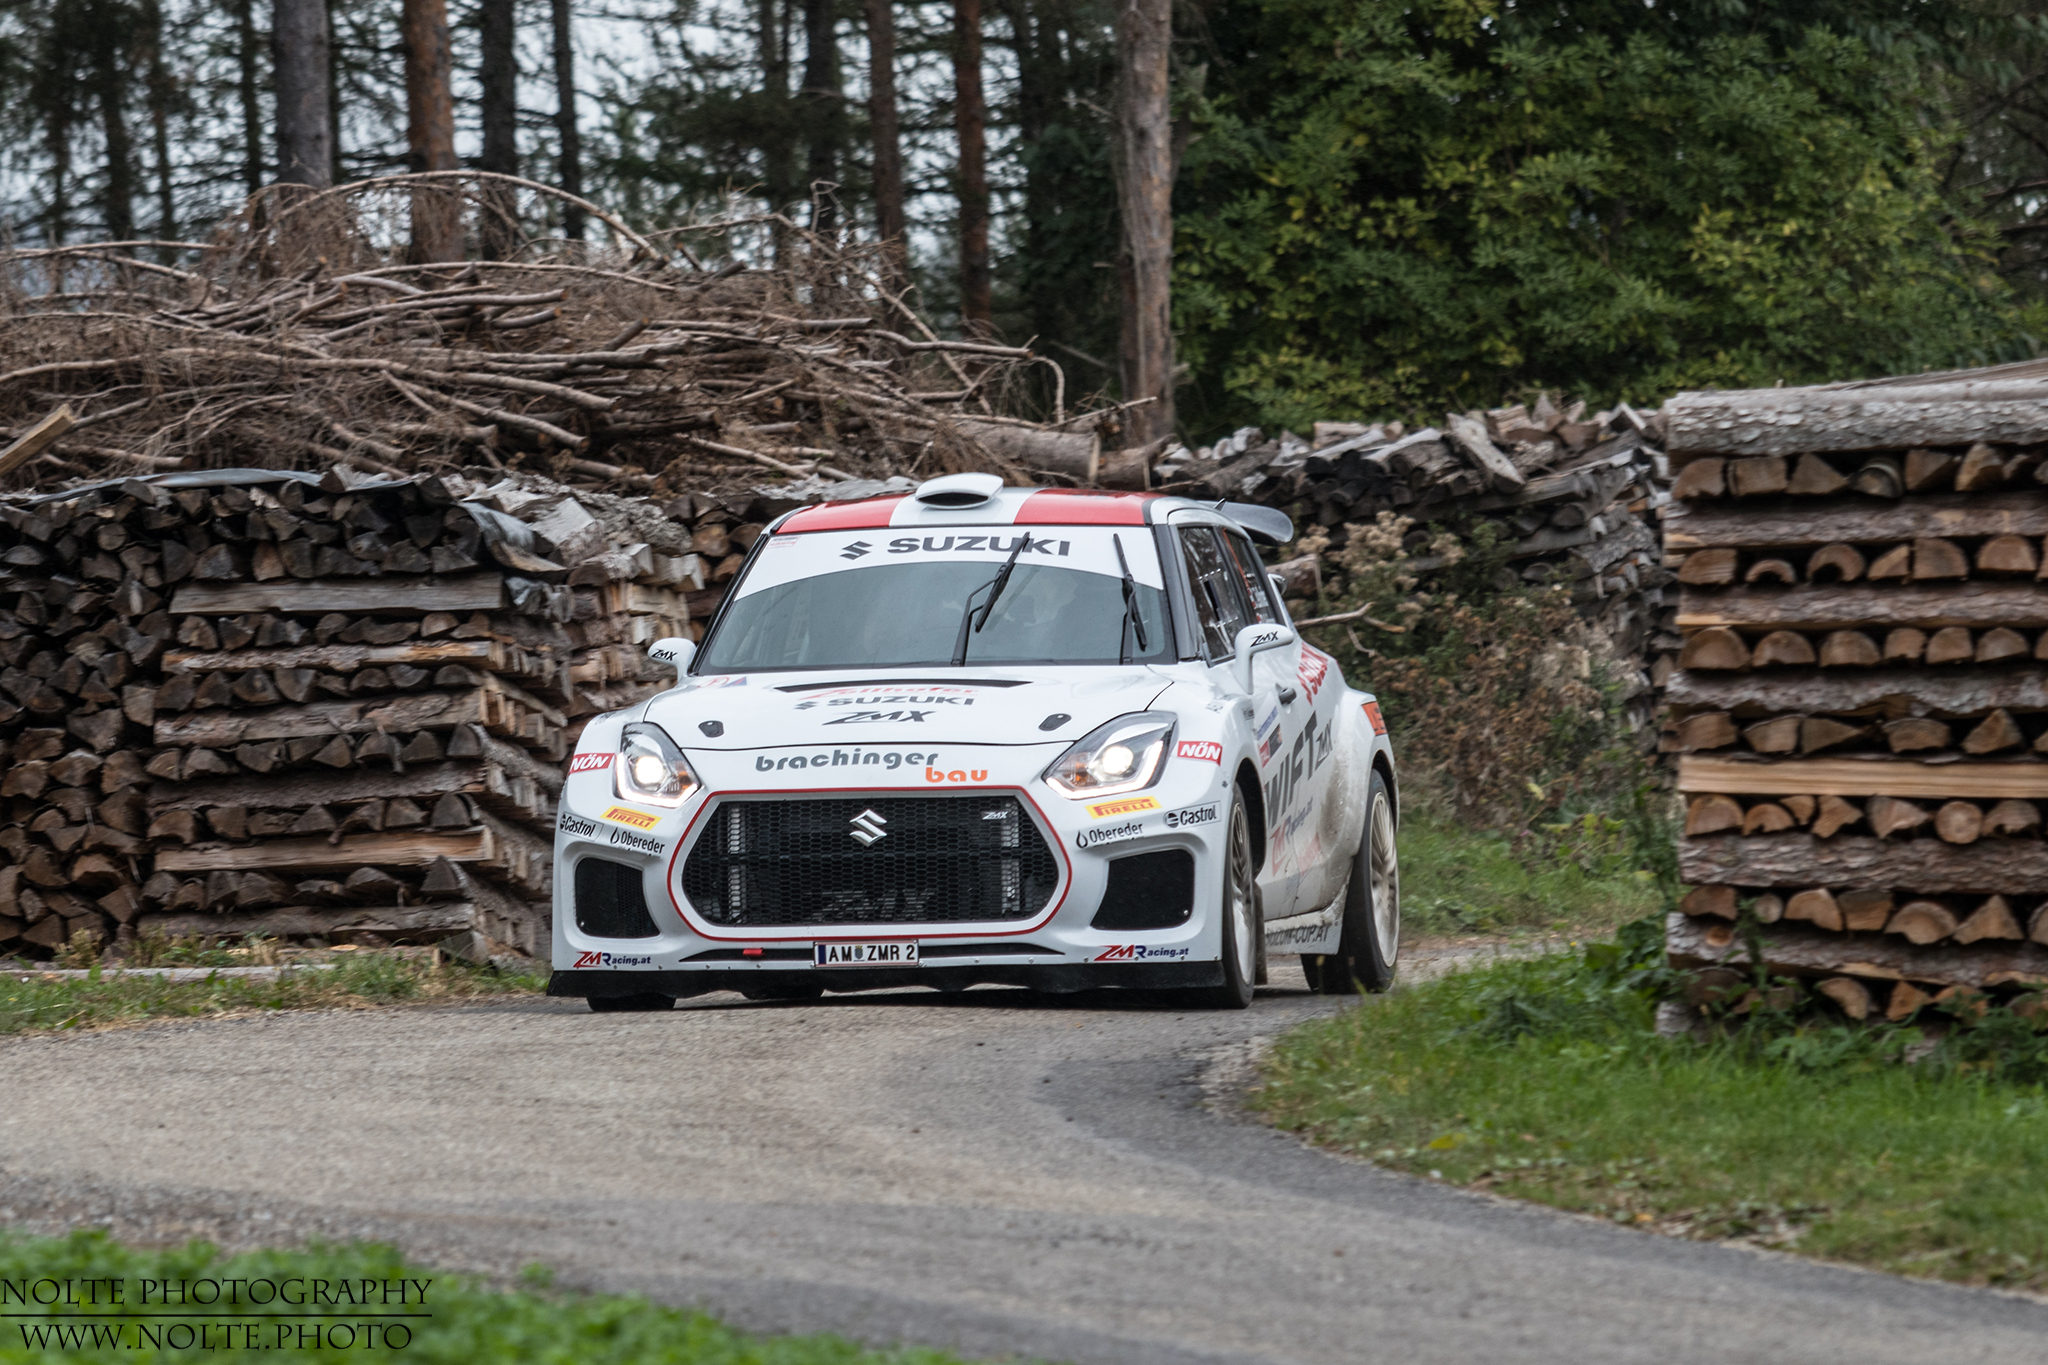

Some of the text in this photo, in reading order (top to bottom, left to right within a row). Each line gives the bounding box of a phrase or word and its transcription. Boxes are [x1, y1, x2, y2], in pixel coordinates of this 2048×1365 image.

[887, 536, 1071, 557] SUZUKI
[1250, 631, 1279, 648] ZMX
[651, 648, 678, 661] ZMX
[827, 695, 975, 706] SUZUKI
[821, 710, 938, 726] ZMX
[755, 748, 939, 773] brachinger
[1179, 742, 1221, 761] NÖN
[571, 753, 609, 771] NÖN
[925, 767, 988, 783] bau
[1093, 798, 1154, 817] PIRELLI
[1180, 804, 1217, 826] Castrol
[565, 815, 597, 837] Castrol
[606, 808, 656, 828] PIRELLI
[620, 830, 666, 854] Obereder
[1089, 822, 1144, 843] Obereder
[829, 944, 916, 962] AM ZMR 2
